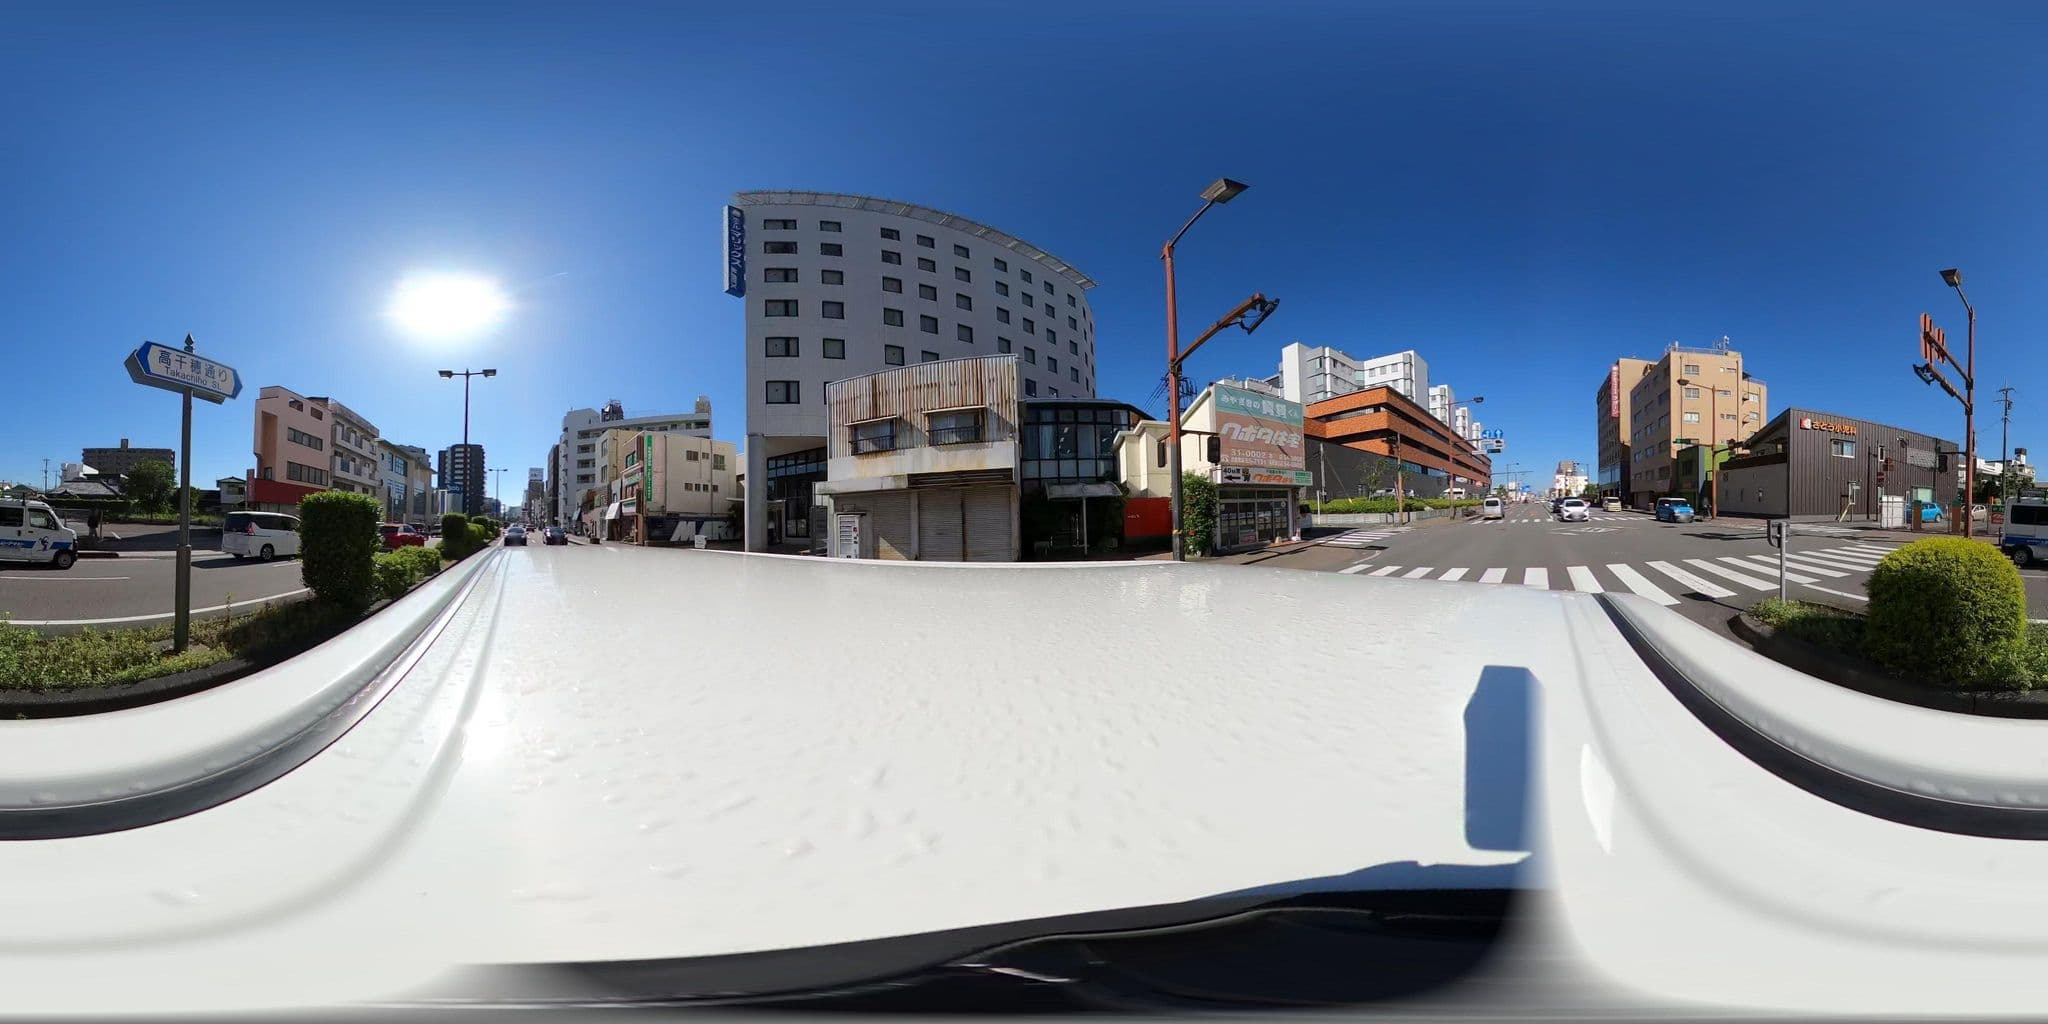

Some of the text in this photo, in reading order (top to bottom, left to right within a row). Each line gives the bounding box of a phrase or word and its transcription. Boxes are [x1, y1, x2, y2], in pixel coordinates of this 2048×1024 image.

[158, 349, 228, 383] 高千穂通り
[165, 366, 208, 386] Takachiho
[1220, 422, 1301, 448] クボタ住宅
[1812, 421, 1856, 435] さとう小児科
